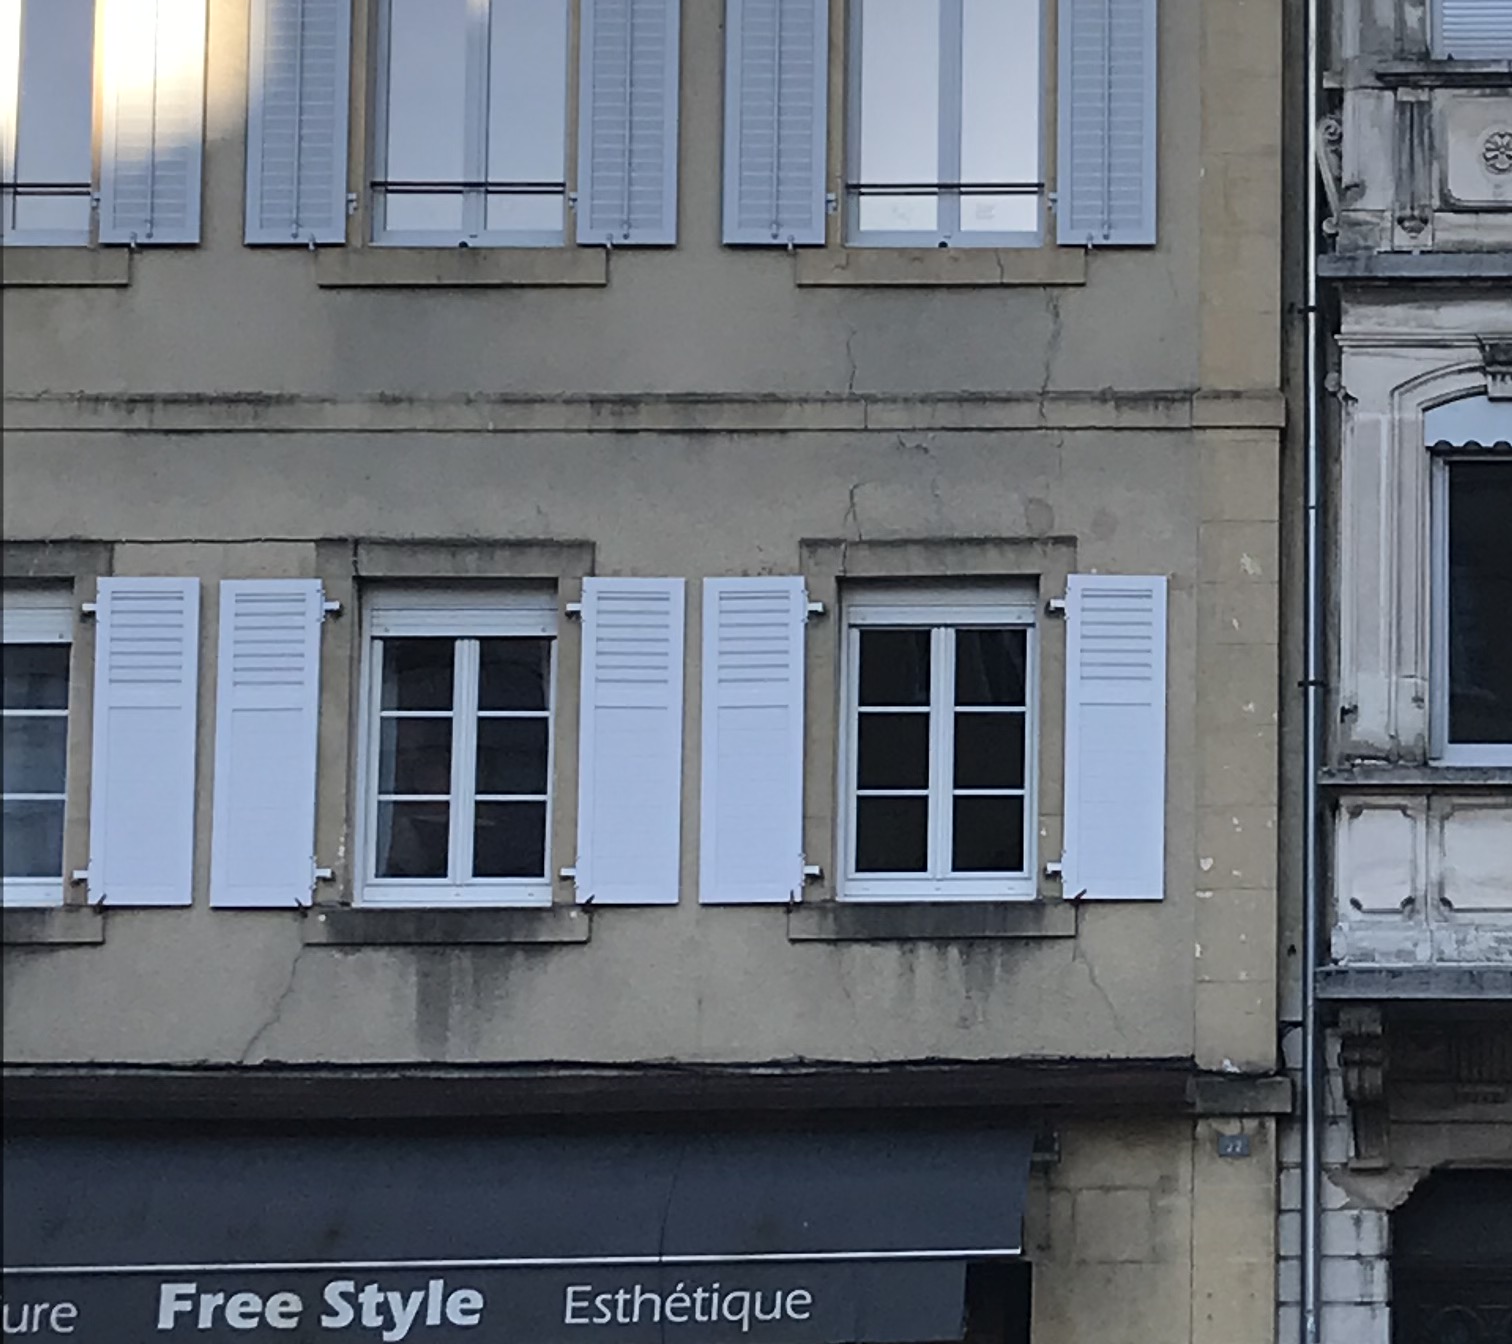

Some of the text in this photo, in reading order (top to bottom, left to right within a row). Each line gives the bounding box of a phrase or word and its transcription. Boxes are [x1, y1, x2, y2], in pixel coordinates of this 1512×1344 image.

[157, 1279, 485, 1342] Free Style
[565, 1282, 812, 1332] Esthétique
